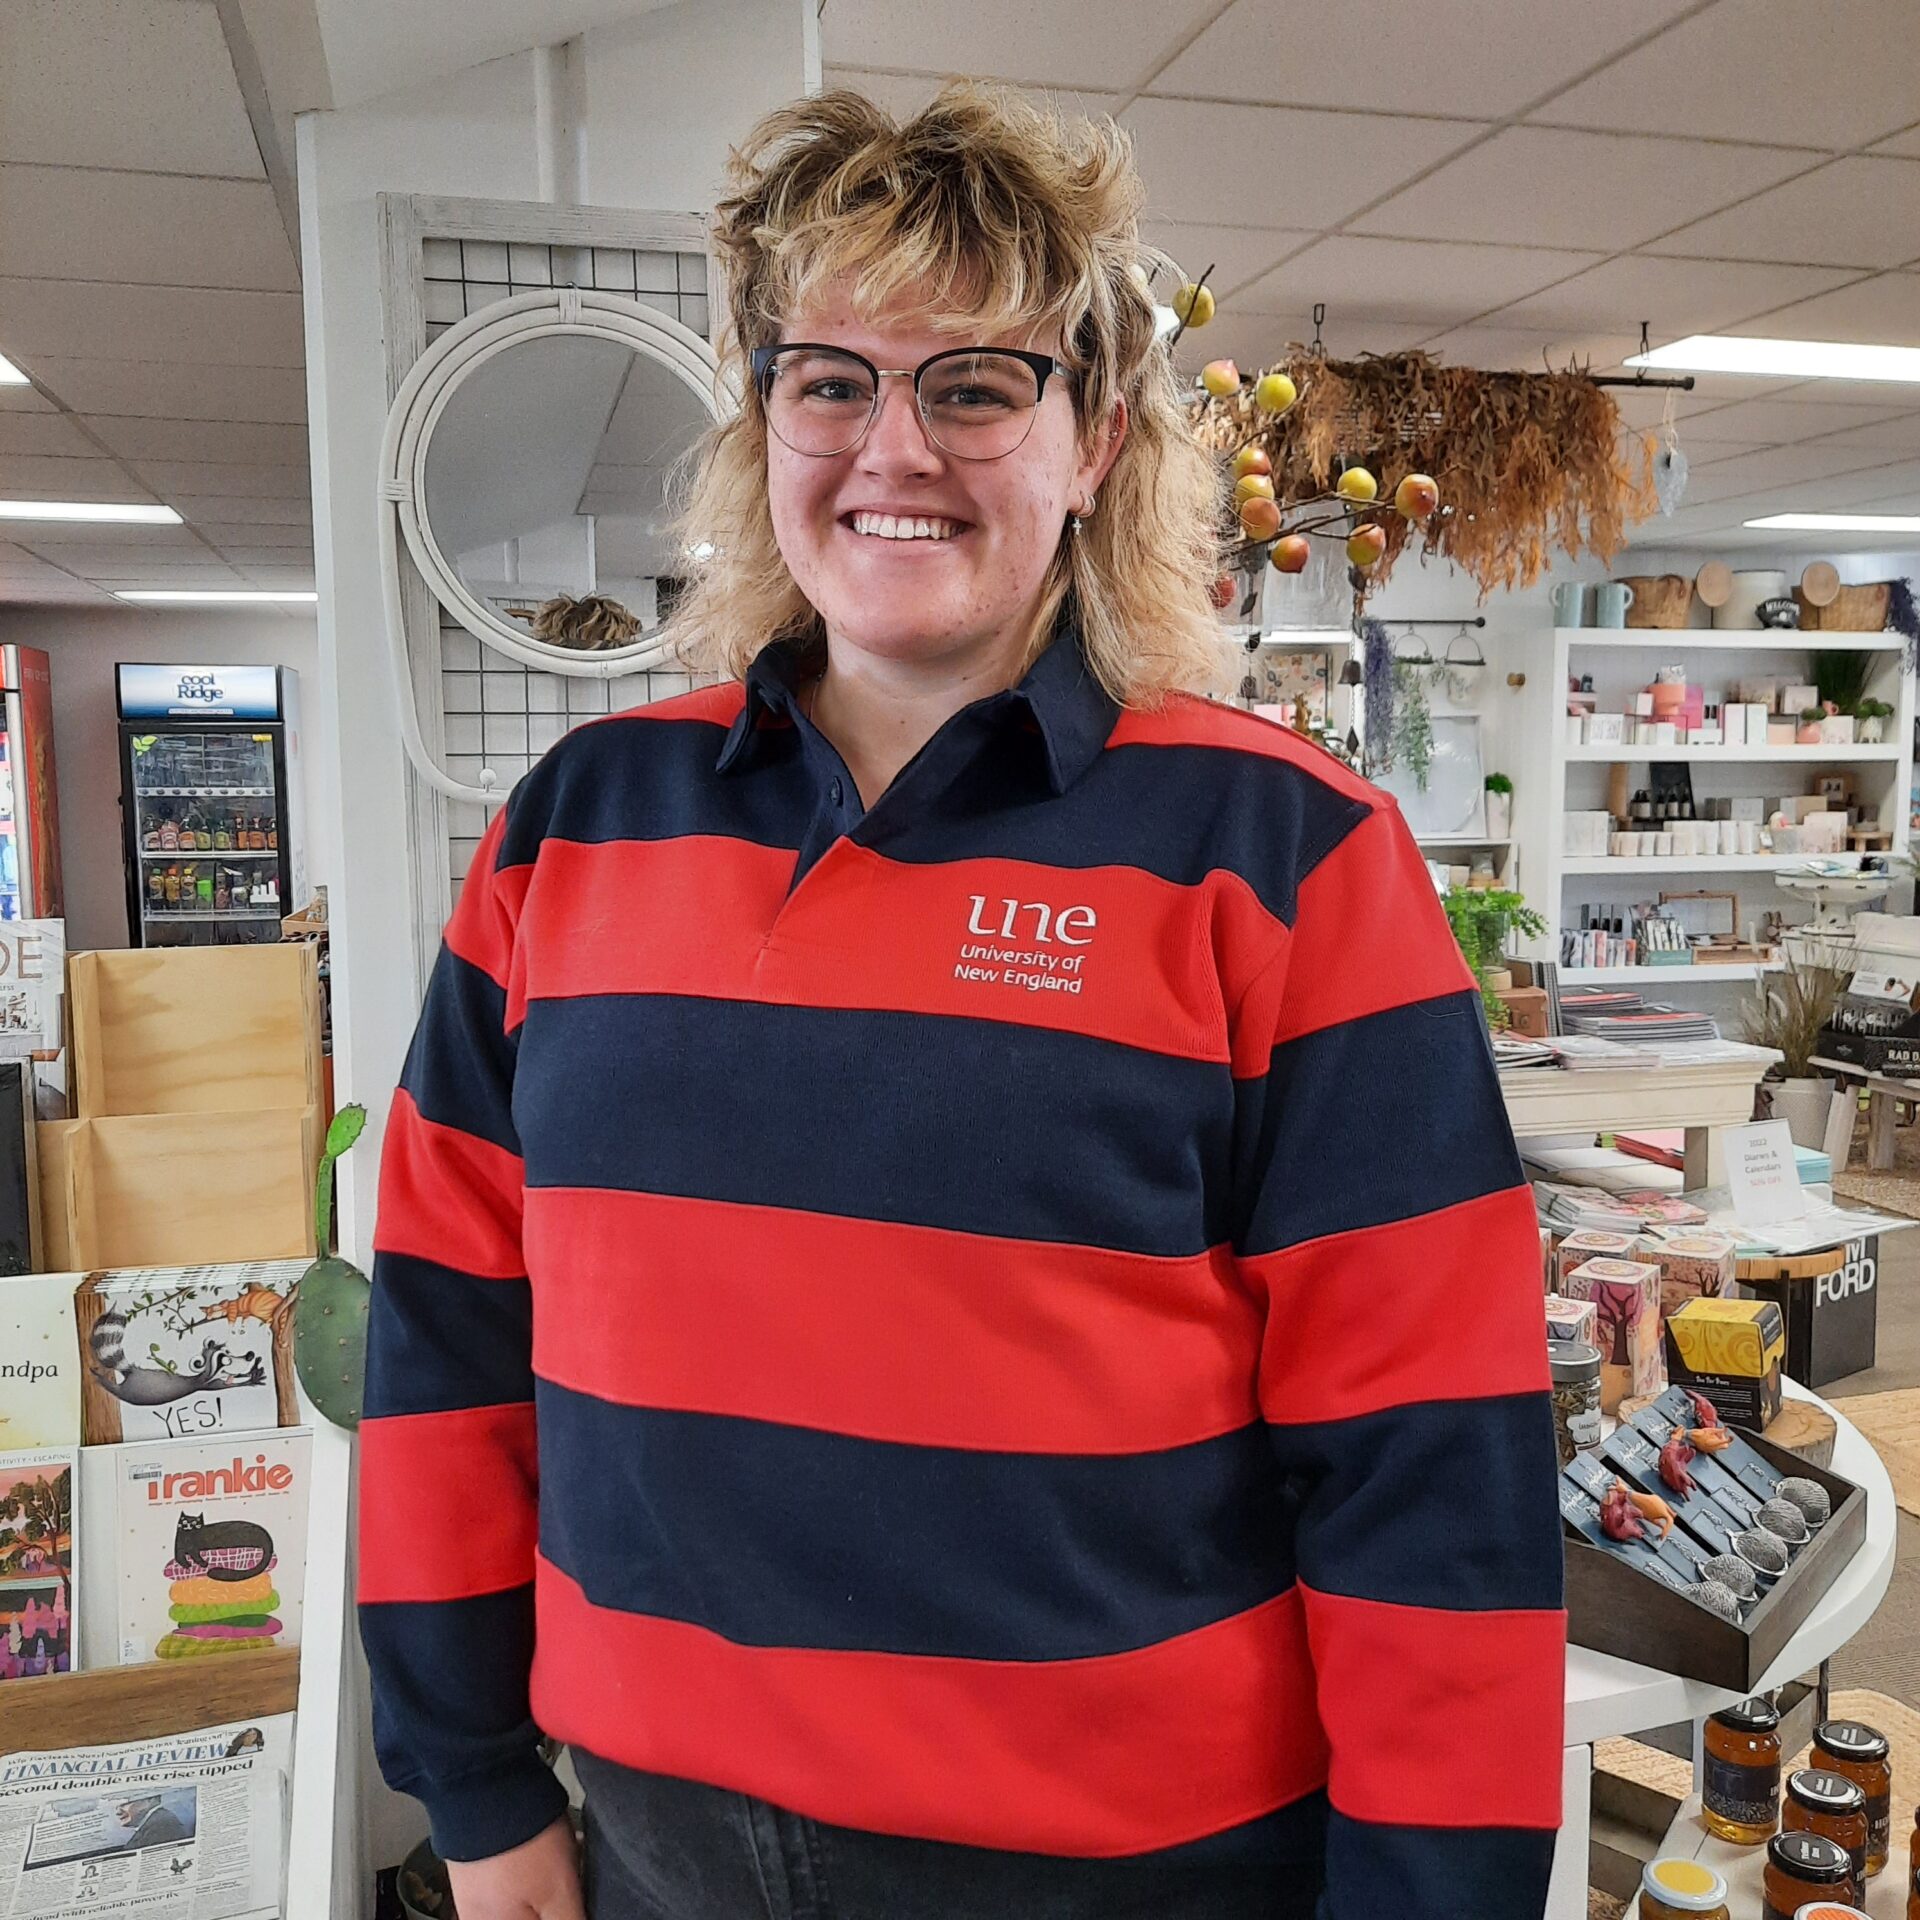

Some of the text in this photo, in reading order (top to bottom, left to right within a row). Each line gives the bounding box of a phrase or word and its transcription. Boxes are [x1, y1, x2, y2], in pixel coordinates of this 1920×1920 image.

[177, 684, 224, 702] Ridge
[181, 673, 216, 685] cool
[968, 895, 1097, 945] une
[960, 944, 1086, 974] University of
[954, 964, 1082, 994] New England
[1888, 1049, 1910, 1061] RAD
[1816, 1258, 1875, 1308] FORD
[152, 1397, 223, 1438] YES!
[3, 1741, 228, 1781] FINANCIAL REVIEW
[61, 1776, 121, 1790] double
[126, 1773, 160, 1783] rate
[164, 1770, 195, 1779] rise
[199, 1759, 253, 1777] tipped
